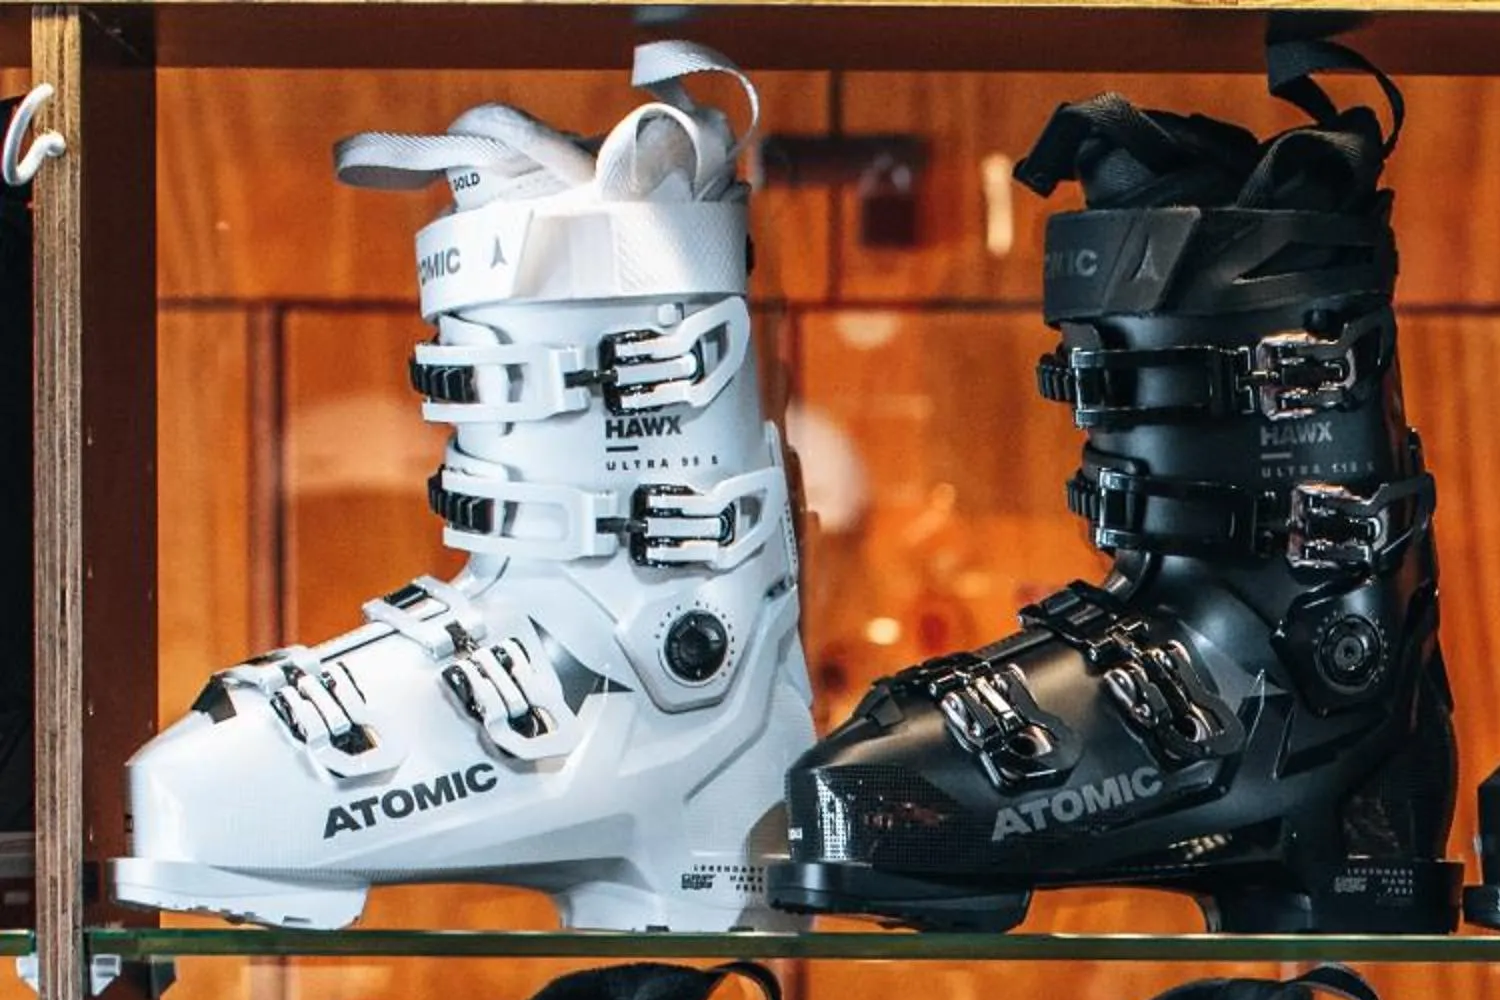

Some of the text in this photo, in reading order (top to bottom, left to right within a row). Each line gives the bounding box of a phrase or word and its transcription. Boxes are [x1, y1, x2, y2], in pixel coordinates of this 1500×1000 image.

[605, 415, 682, 439] HAWX
[1260, 421, 1334, 447] HAWX
[605, 459, 669, 471] ULTRA
[1261, 464, 1321, 478] ULTRA
[323, 763, 498, 840] ATOMIC
[991, 766, 1163, 842] ATOMIC
